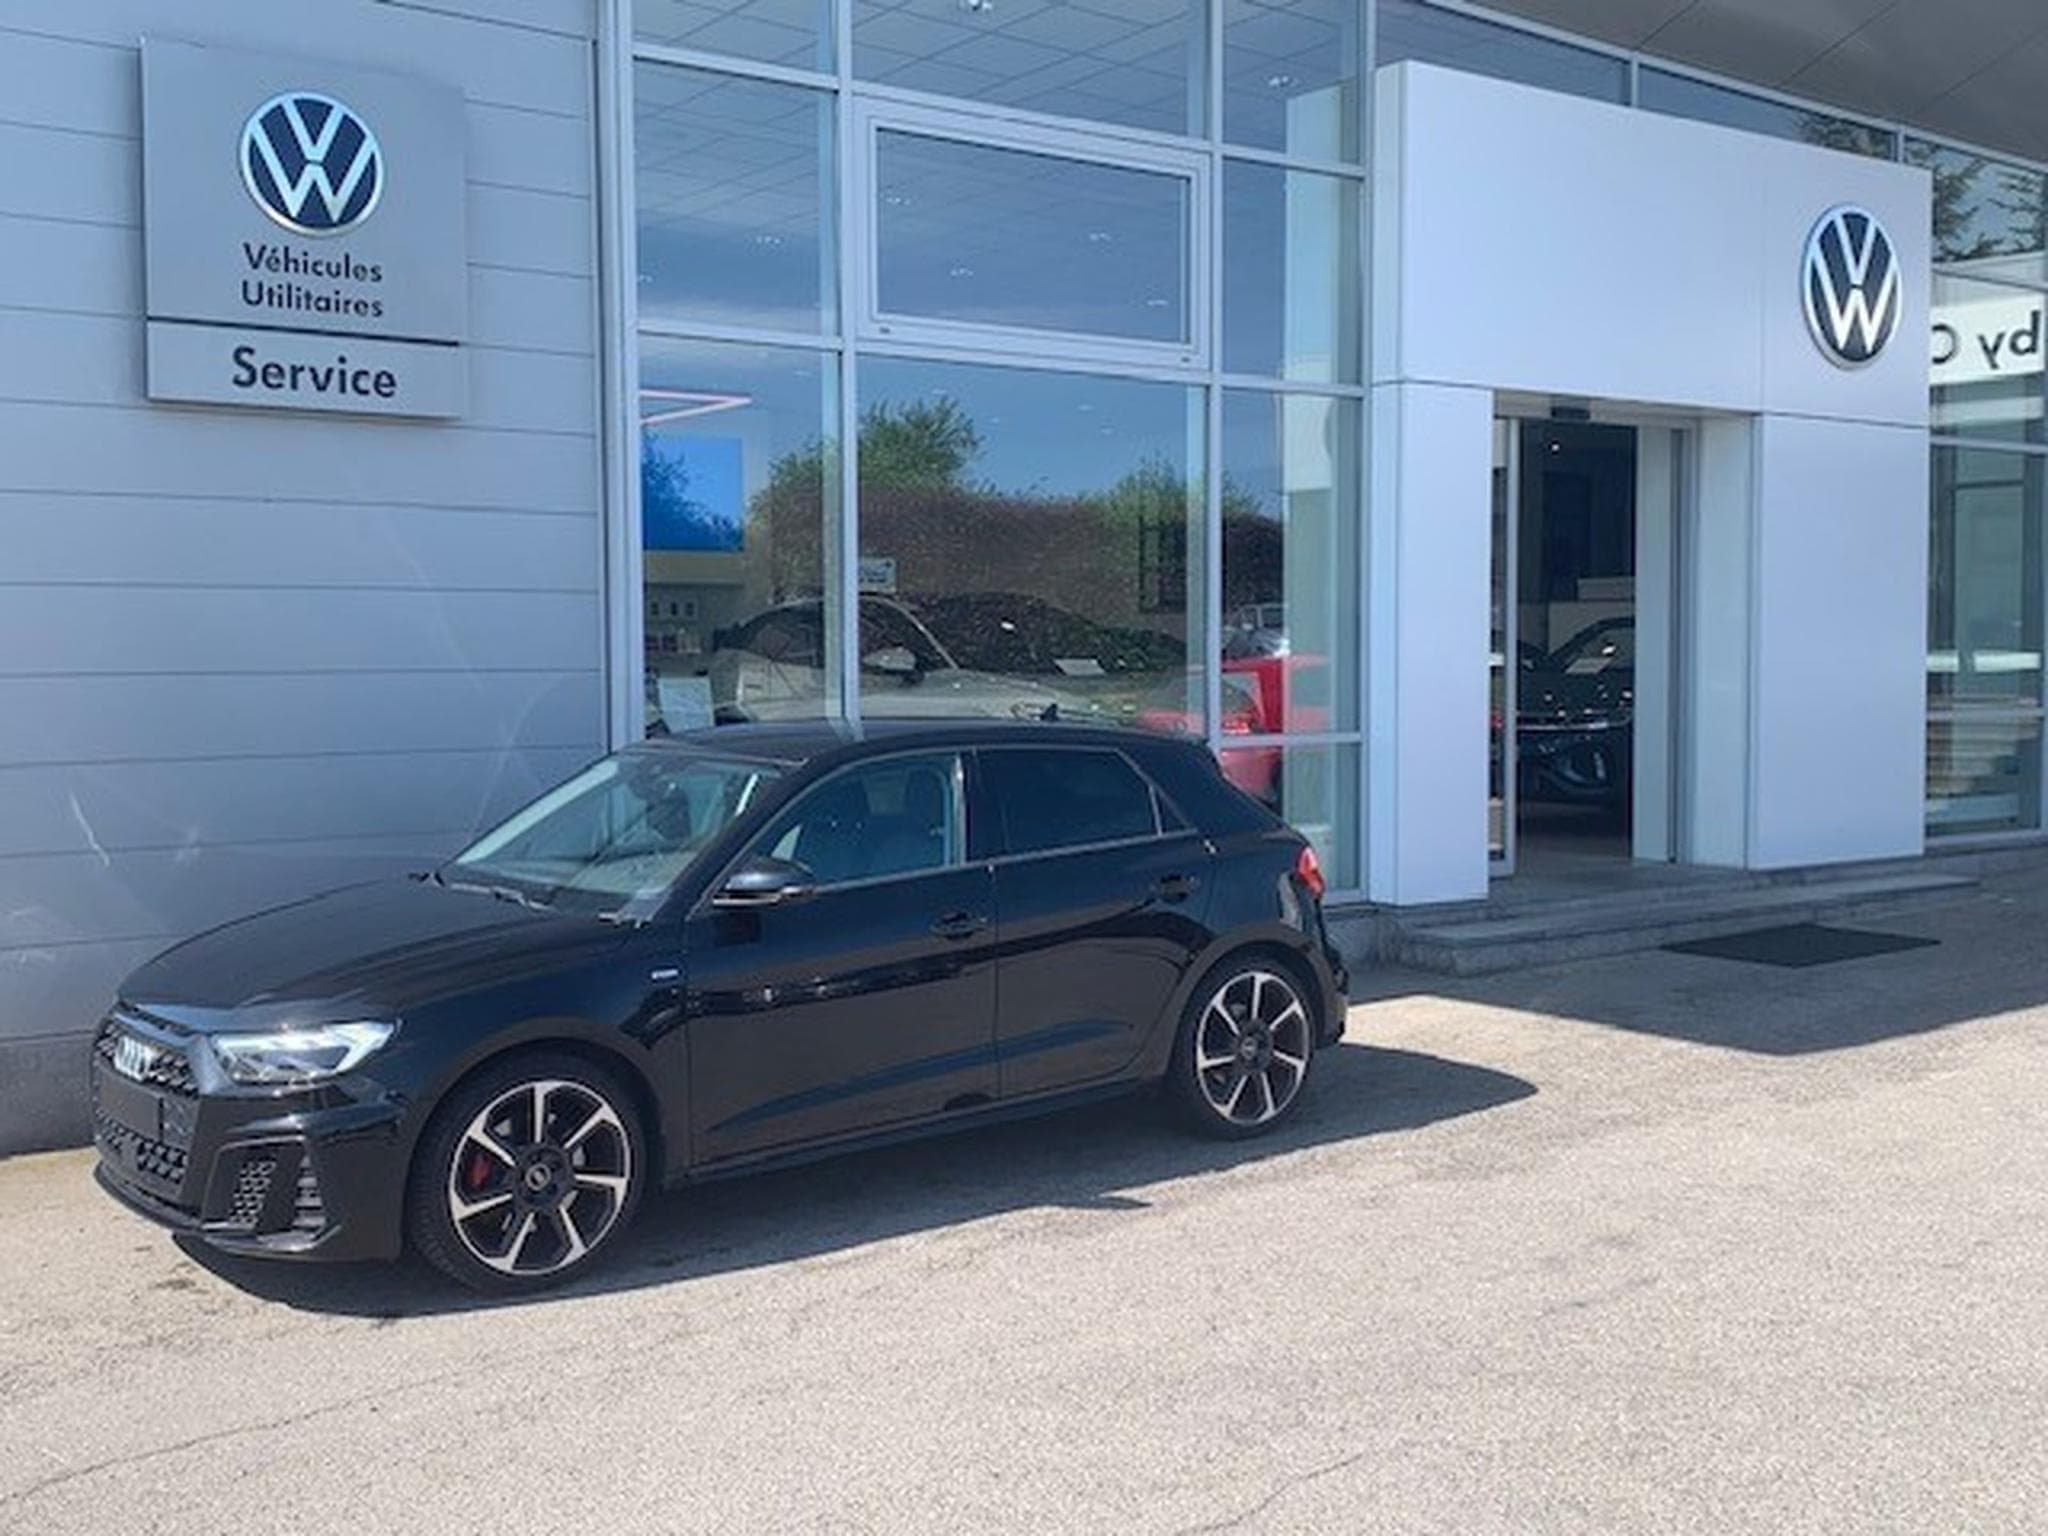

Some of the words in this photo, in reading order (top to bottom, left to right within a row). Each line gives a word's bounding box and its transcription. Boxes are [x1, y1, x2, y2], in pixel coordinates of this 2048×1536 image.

[242, 241, 383, 283] Véhicules
[241, 280, 384, 318] Utilitaires
[232, 345, 398, 398] Service
